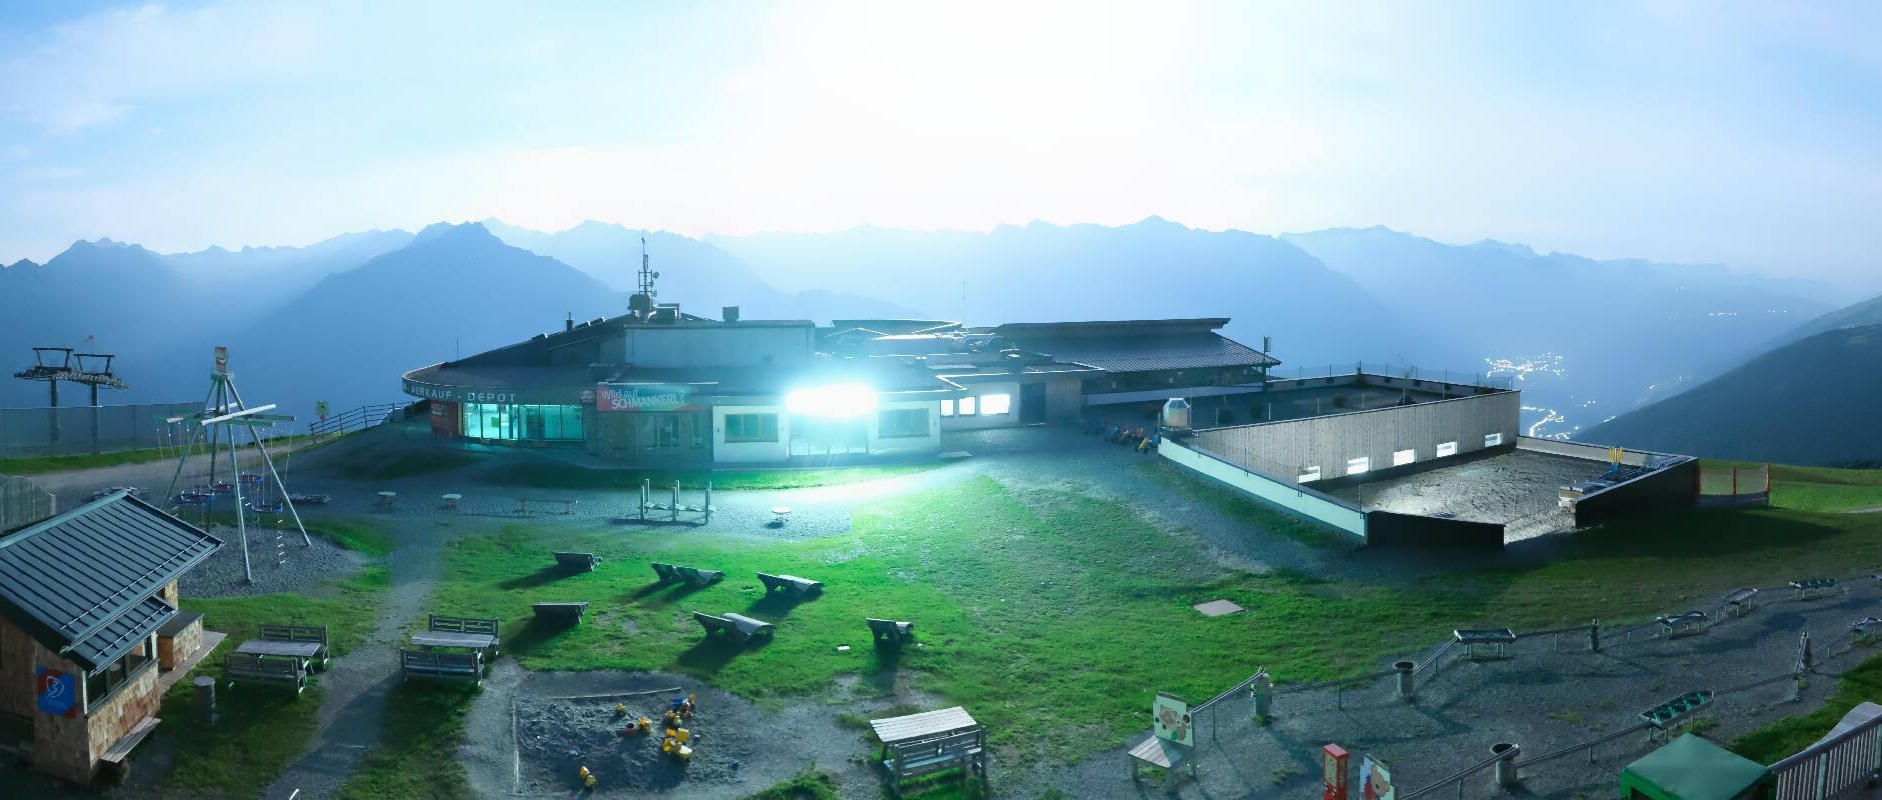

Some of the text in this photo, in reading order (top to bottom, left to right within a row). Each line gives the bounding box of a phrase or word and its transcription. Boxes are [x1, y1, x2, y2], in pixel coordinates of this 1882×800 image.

[411, 386, 452, 399] VERKAUF
[467, 392, 516, 402] DEPOT
[601, 389, 622, 400] Wild
